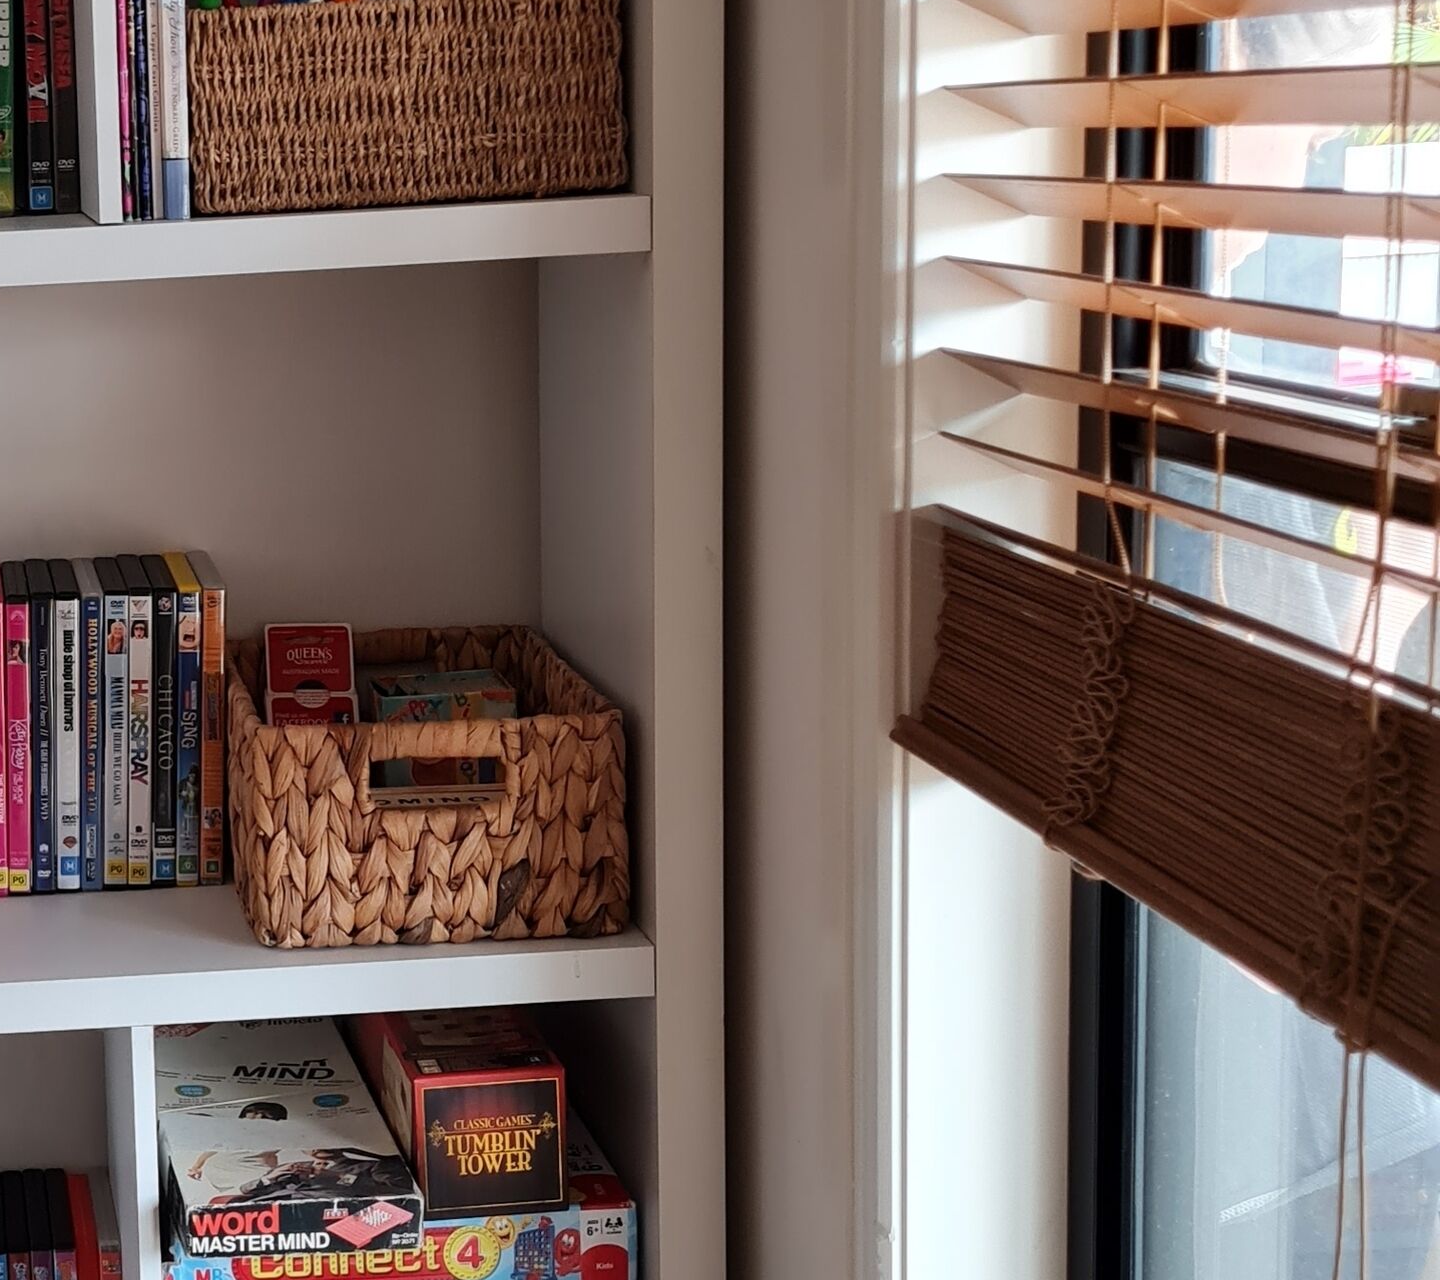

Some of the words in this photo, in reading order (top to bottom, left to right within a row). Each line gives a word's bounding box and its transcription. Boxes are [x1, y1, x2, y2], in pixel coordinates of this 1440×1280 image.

[88, 618, 98, 695] HOLLYWOOD
[87, 699, 98, 749] MUSICALS
[131, 679, 149, 786] HAIRSPRAY
[157, 674, 174, 771] CHICAGO
[13, 876, 25, 885] PG
[453, 1117, 496, 1131] CLASSIC
[496, 1114, 533, 1128] GAMES
[445, 1129, 542, 1157] TUMBLIN'
[456, 1151, 533, 1177] TOWER
[192, 1204, 280, 1237] word
[191, 1233, 275, 1254] MASTER
[278, 1232, 331, 1251] MIND
[455, 1234, 487, 1270] 4
[596, 1262, 614, 1271] Kids
